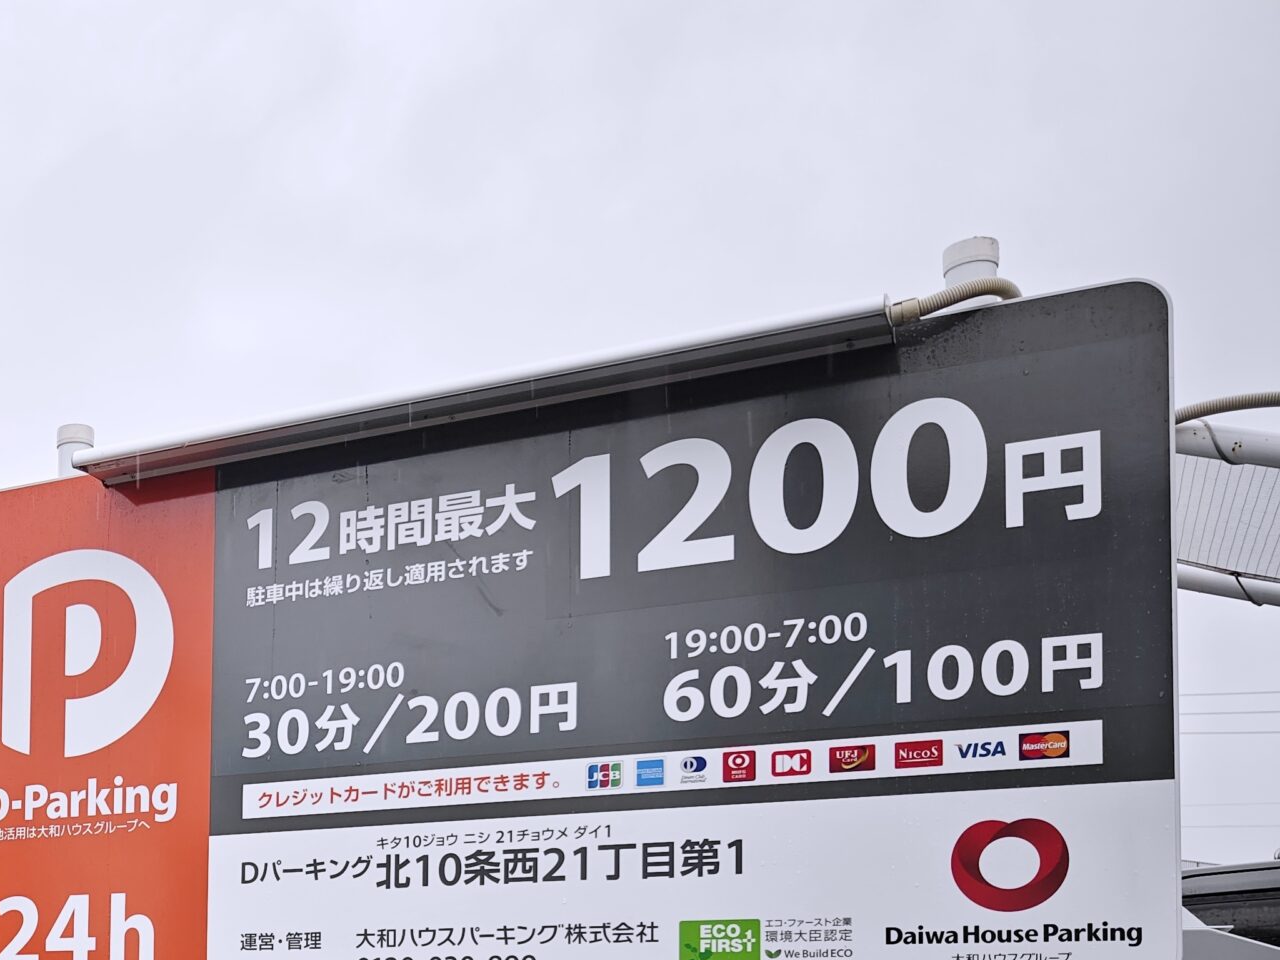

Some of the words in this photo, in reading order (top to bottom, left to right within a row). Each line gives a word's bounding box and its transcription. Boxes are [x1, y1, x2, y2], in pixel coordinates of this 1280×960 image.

[246, 483, 537, 569] 12時間最大
[551, 397, 1101, 580] 1200円
[246, 549, 534, 608] 駐車中は繰り返し適用されます
[664, 611, 867, 660] 19:00-7:00
[245, 661, 405, 703] 7:00-19:00
[836, 750, 857, 760] UFJ
[955, 741, 1006, 758] VISA
[1022, 740, 1066, 751] MasterCard
[775, 753, 807, 772] DC
[258, 773, 562, 810] クレジットカードがご利用できます。
[240, 931, 322, 952] 運営・管理
[356, 922, 659, 949] 大和ハウスパーキング株式会社
[700, 924, 740, 938] ECO
[765, 929, 853, 943] 環境大臣認定
[885, 925, 959, 946] Daiwa
[962, 924, 1039, 945] House
[1042, 921, 1143, 947] Parking
[784, 949, 800, 958] We
[802, 949, 829, 958] Build
[830, 949, 853, 958] ECO
